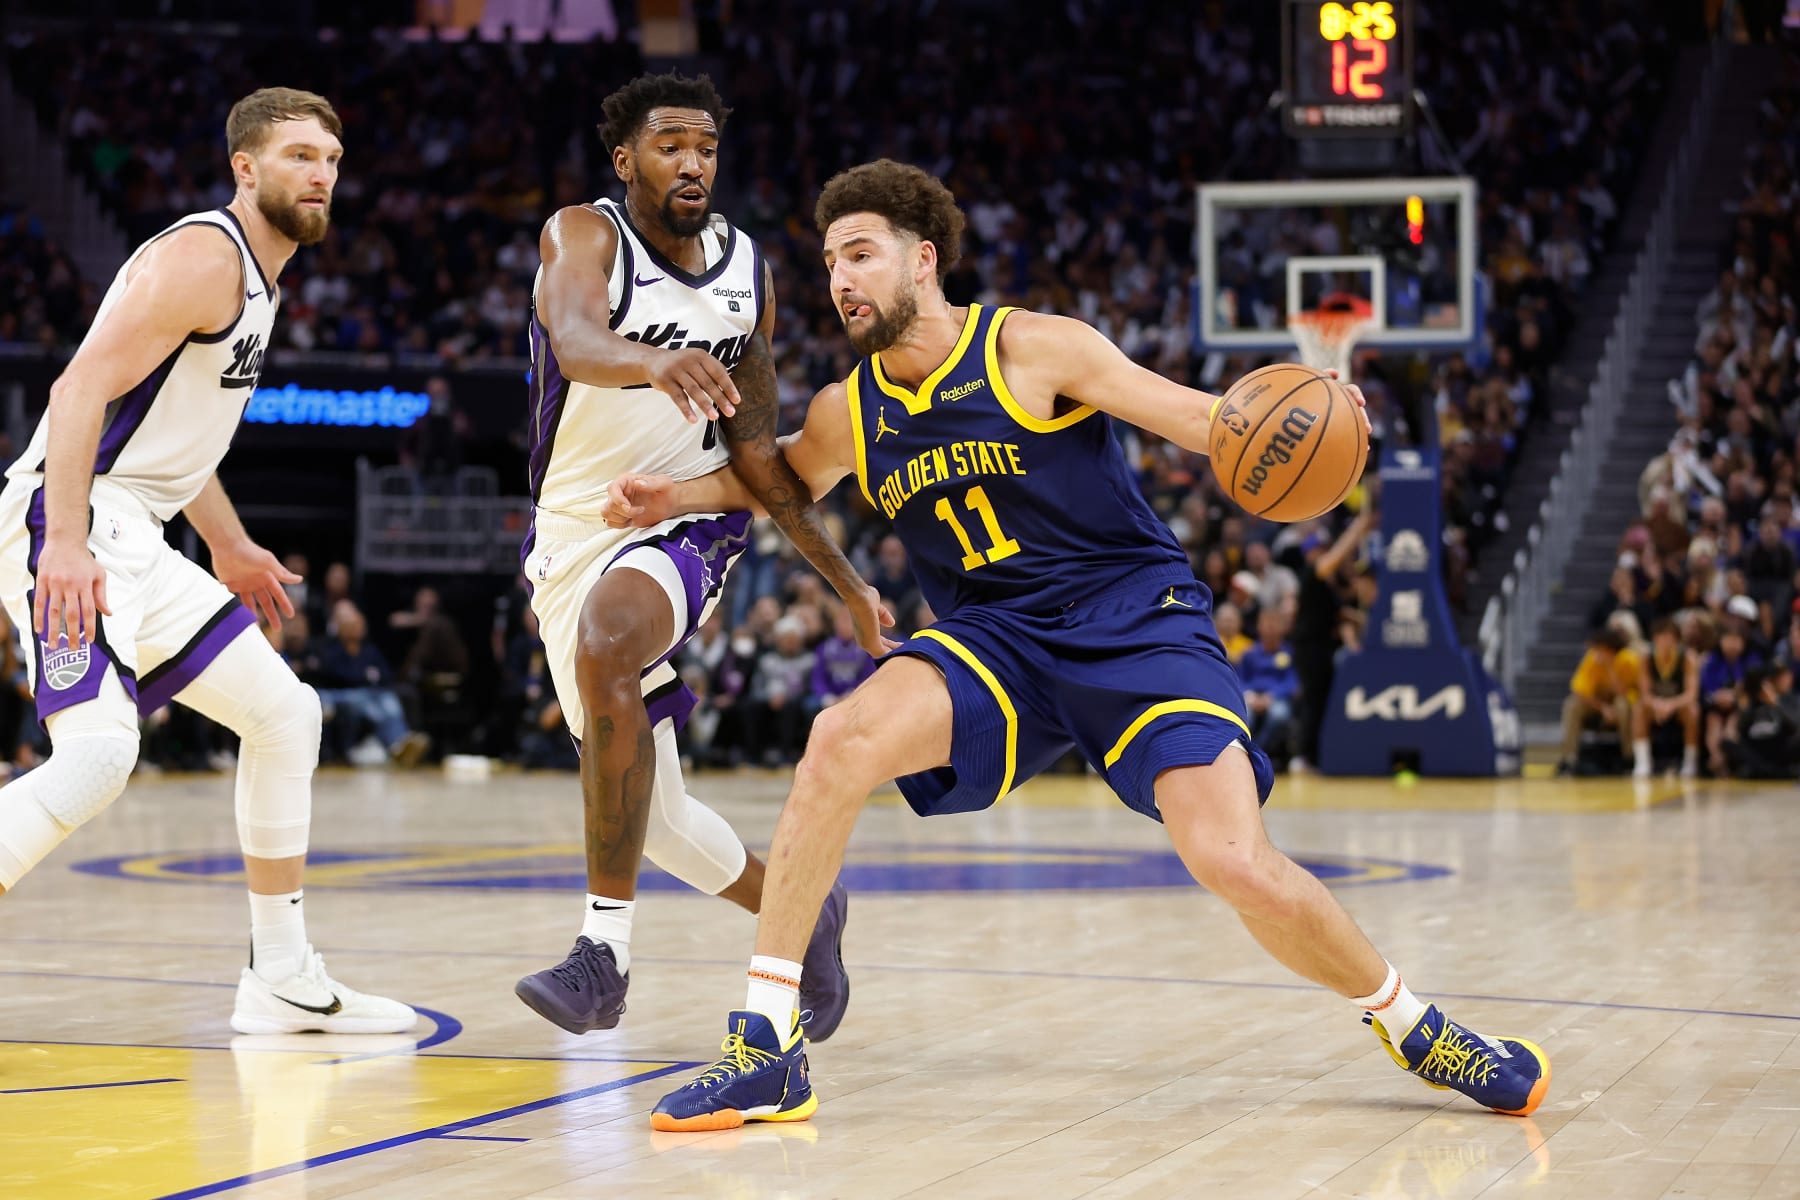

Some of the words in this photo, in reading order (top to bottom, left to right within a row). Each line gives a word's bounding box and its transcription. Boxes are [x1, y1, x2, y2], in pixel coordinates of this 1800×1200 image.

[1319, 1, 1397, 41] 8:25
[1332, 39, 1388, 99] 12
[712, 287, 752, 300] dialpad
[940, 378, 985, 402] Rakuten
[1241, 406, 1319, 496] Wilson
[878, 446, 950, 520] GOLDEN
[950, 441, 1027, 476] STATE
[934, 485, 1021, 571] 11
[46, 651, 88, 673] KINGS
[1344, 684, 1466, 721] KIA
[1420, 1023, 1434, 1041] 11
